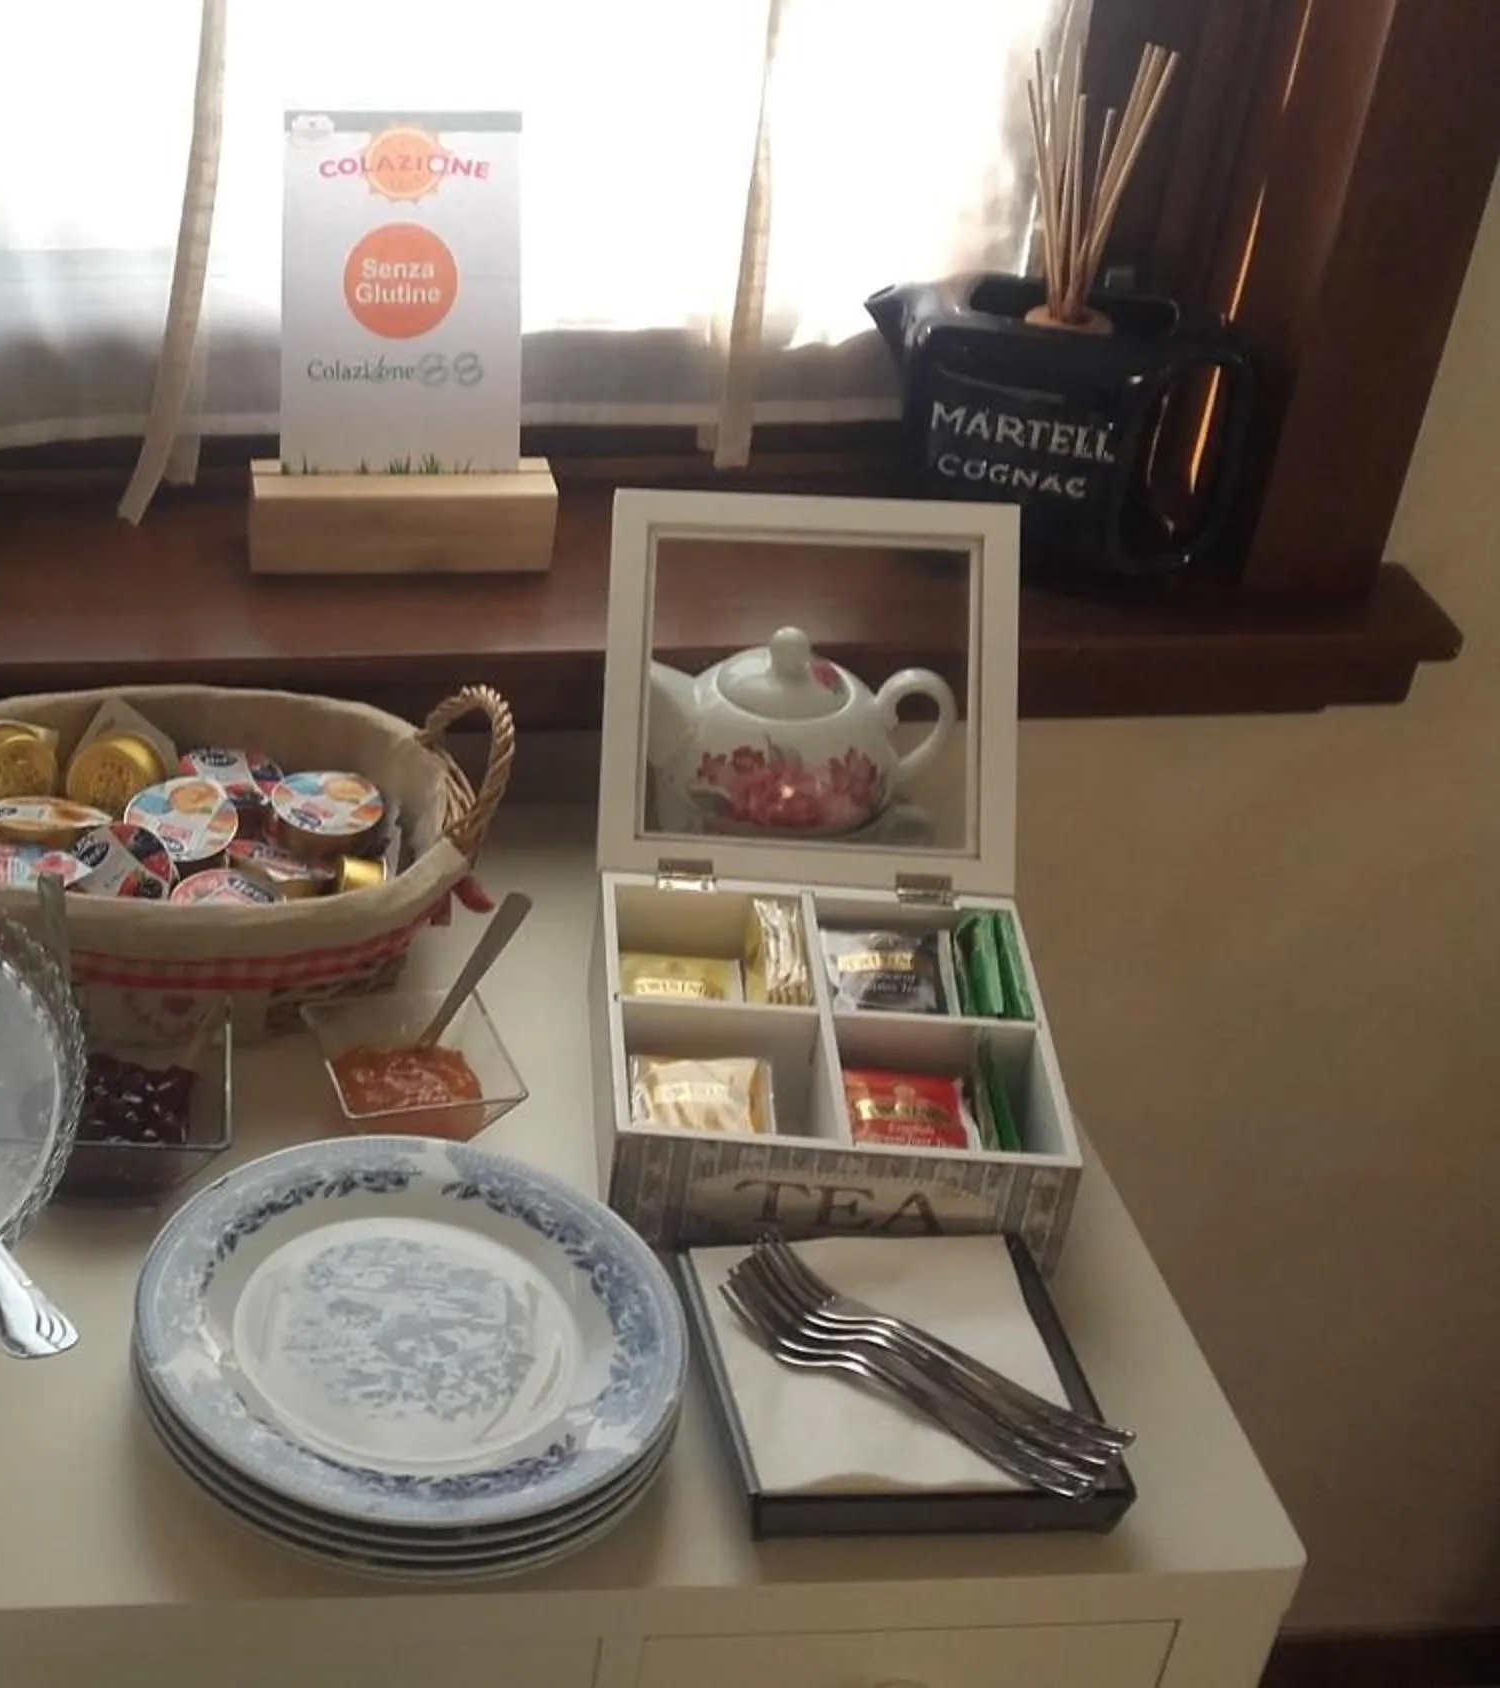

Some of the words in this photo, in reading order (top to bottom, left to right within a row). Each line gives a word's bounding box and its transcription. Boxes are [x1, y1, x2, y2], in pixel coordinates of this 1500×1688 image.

[318, 154, 492, 180] COLAZIONE
[361, 258, 435, 279] Senza
[355, 282, 441, 305] Glutine
[931, 400, 1116, 464] MARTELL
[937, 454, 1089, 499] COGNAC
[733, 1179, 945, 1235] TEA
